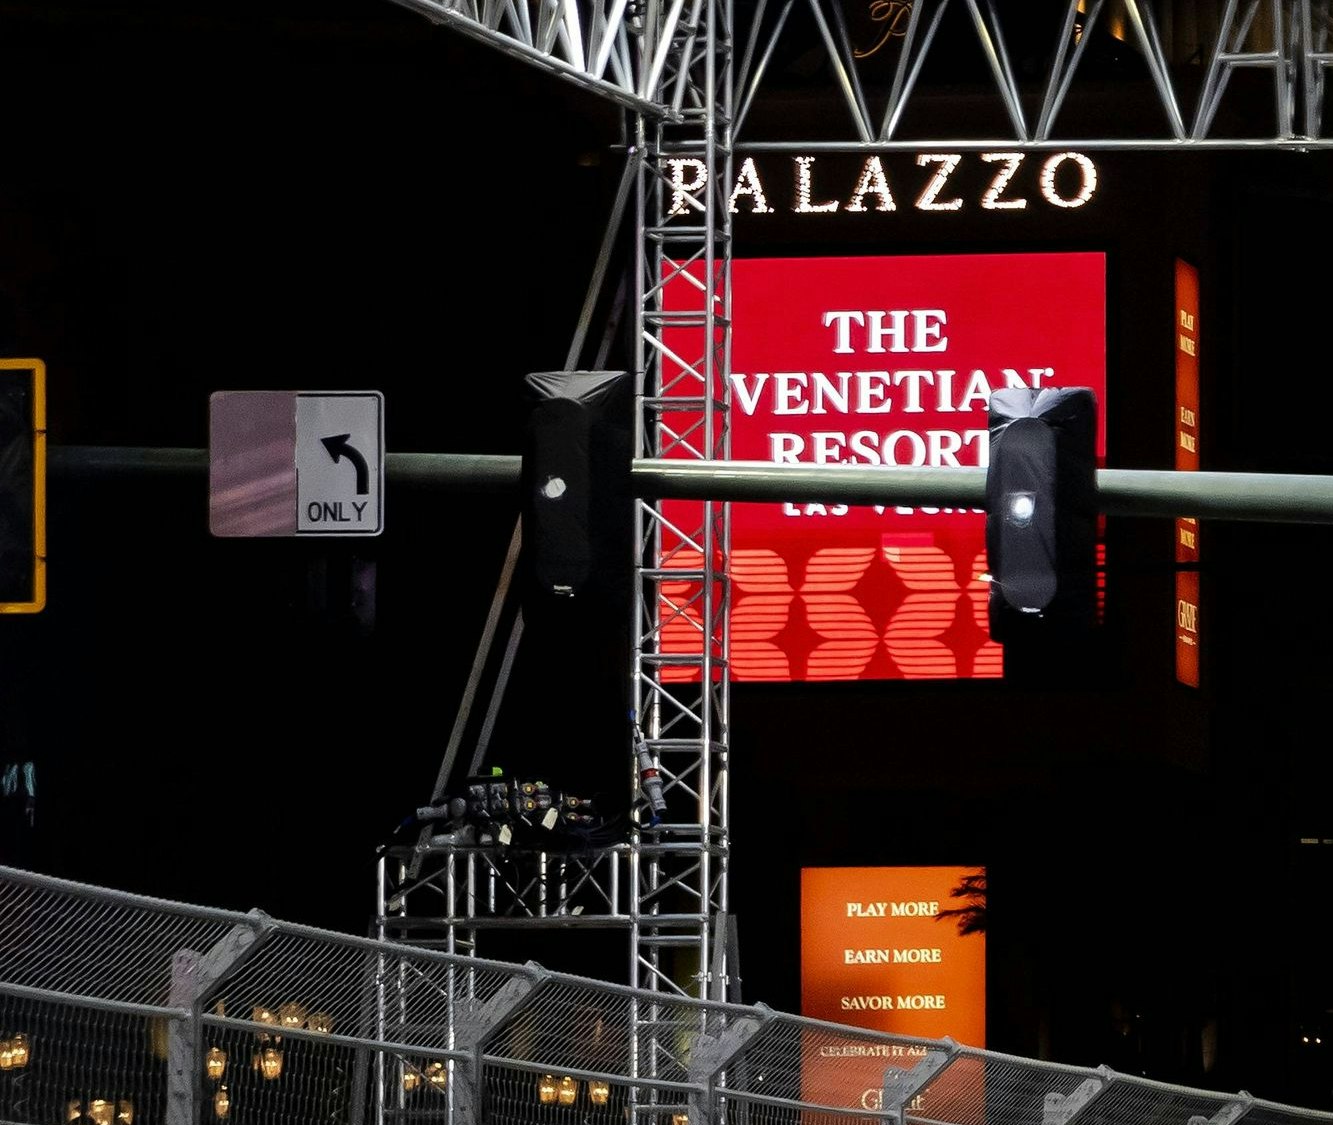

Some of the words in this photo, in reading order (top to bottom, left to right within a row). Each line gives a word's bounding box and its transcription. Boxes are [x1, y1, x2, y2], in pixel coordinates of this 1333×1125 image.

[666, 152, 1099, 213] PALAZZO
[823, 309, 949, 353] THE
[307, 501, 368, 524] ONLY
[846, 901, 887, 917] PLAY
[890, 901, 939, 917] MORE
[843, 949, 889, 964] EARN
[893, 949, 942, 964] MORE
[840, 996, 893, 1011] SAVOR
[896, 996, 946, 1010] MORE
